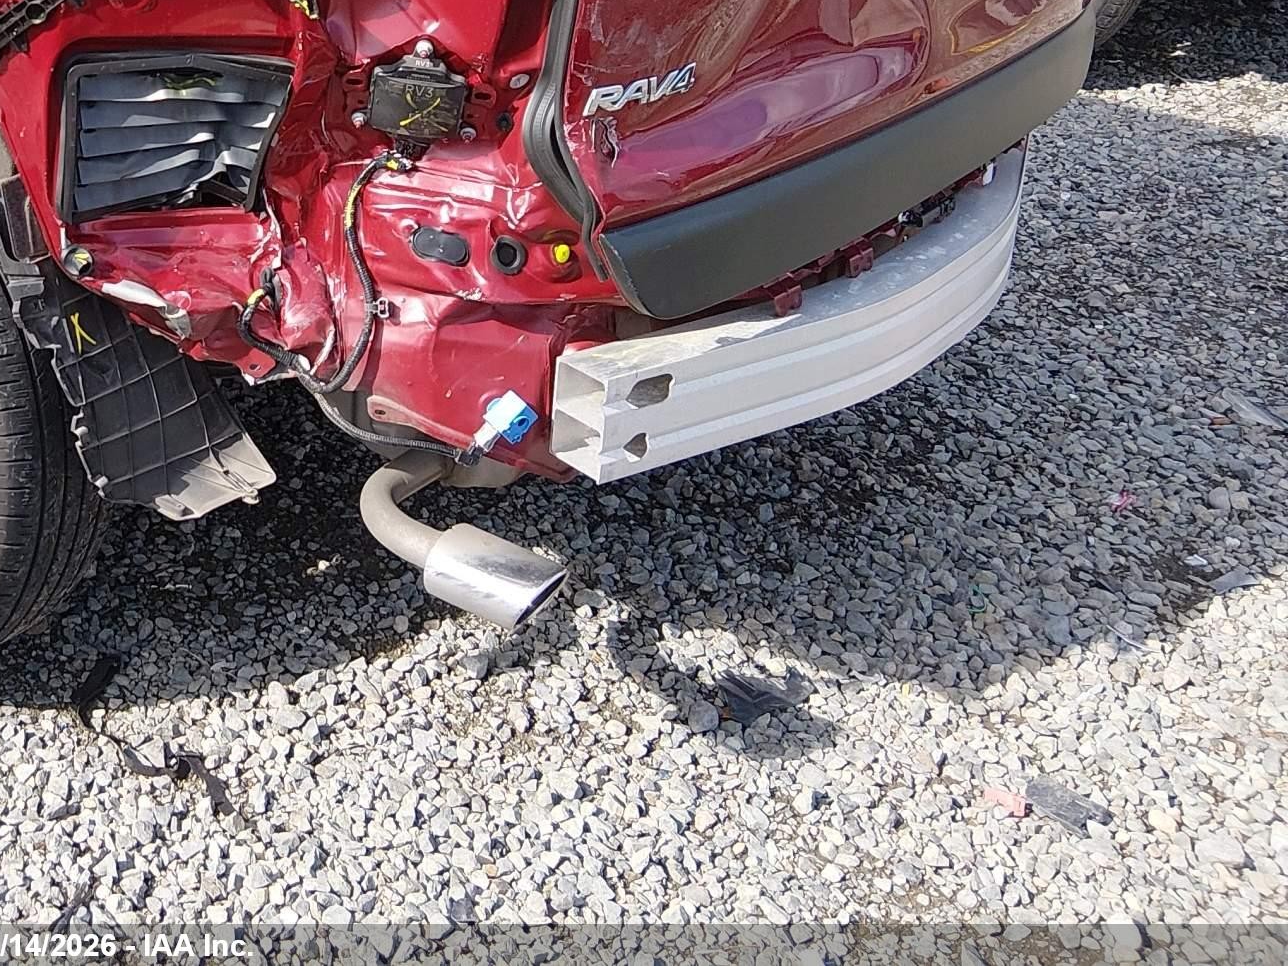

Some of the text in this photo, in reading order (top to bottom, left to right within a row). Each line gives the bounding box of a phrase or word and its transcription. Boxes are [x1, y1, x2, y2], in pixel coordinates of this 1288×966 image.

[415, 59, 430, 68] RV3
[405, 84, 434, 98] RV3
[582, 62, 697, 117] RAV4
